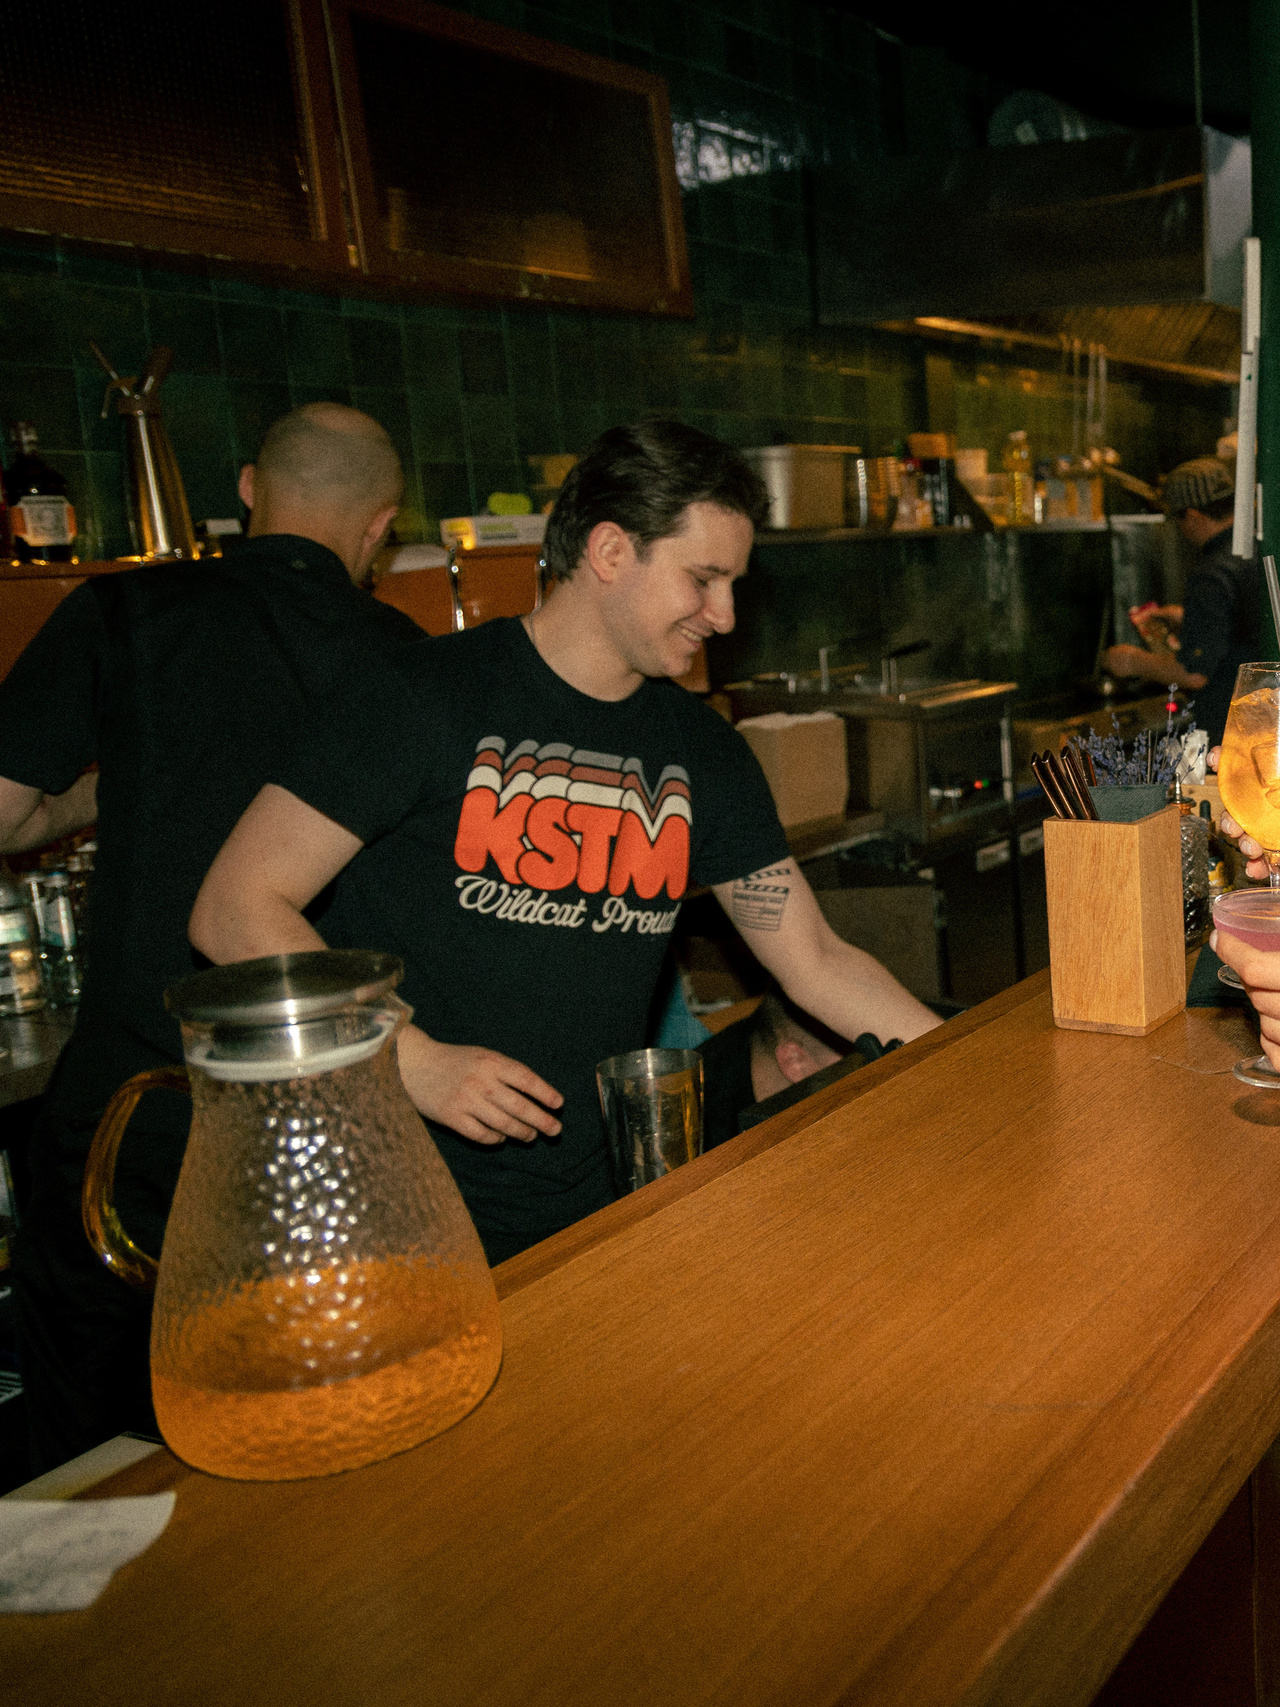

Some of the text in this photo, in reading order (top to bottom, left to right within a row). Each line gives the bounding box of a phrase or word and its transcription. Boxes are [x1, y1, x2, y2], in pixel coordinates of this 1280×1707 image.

[455, 785, 691, 899] KSTM
[455, 875, 681, 935] Wildcat Proud
